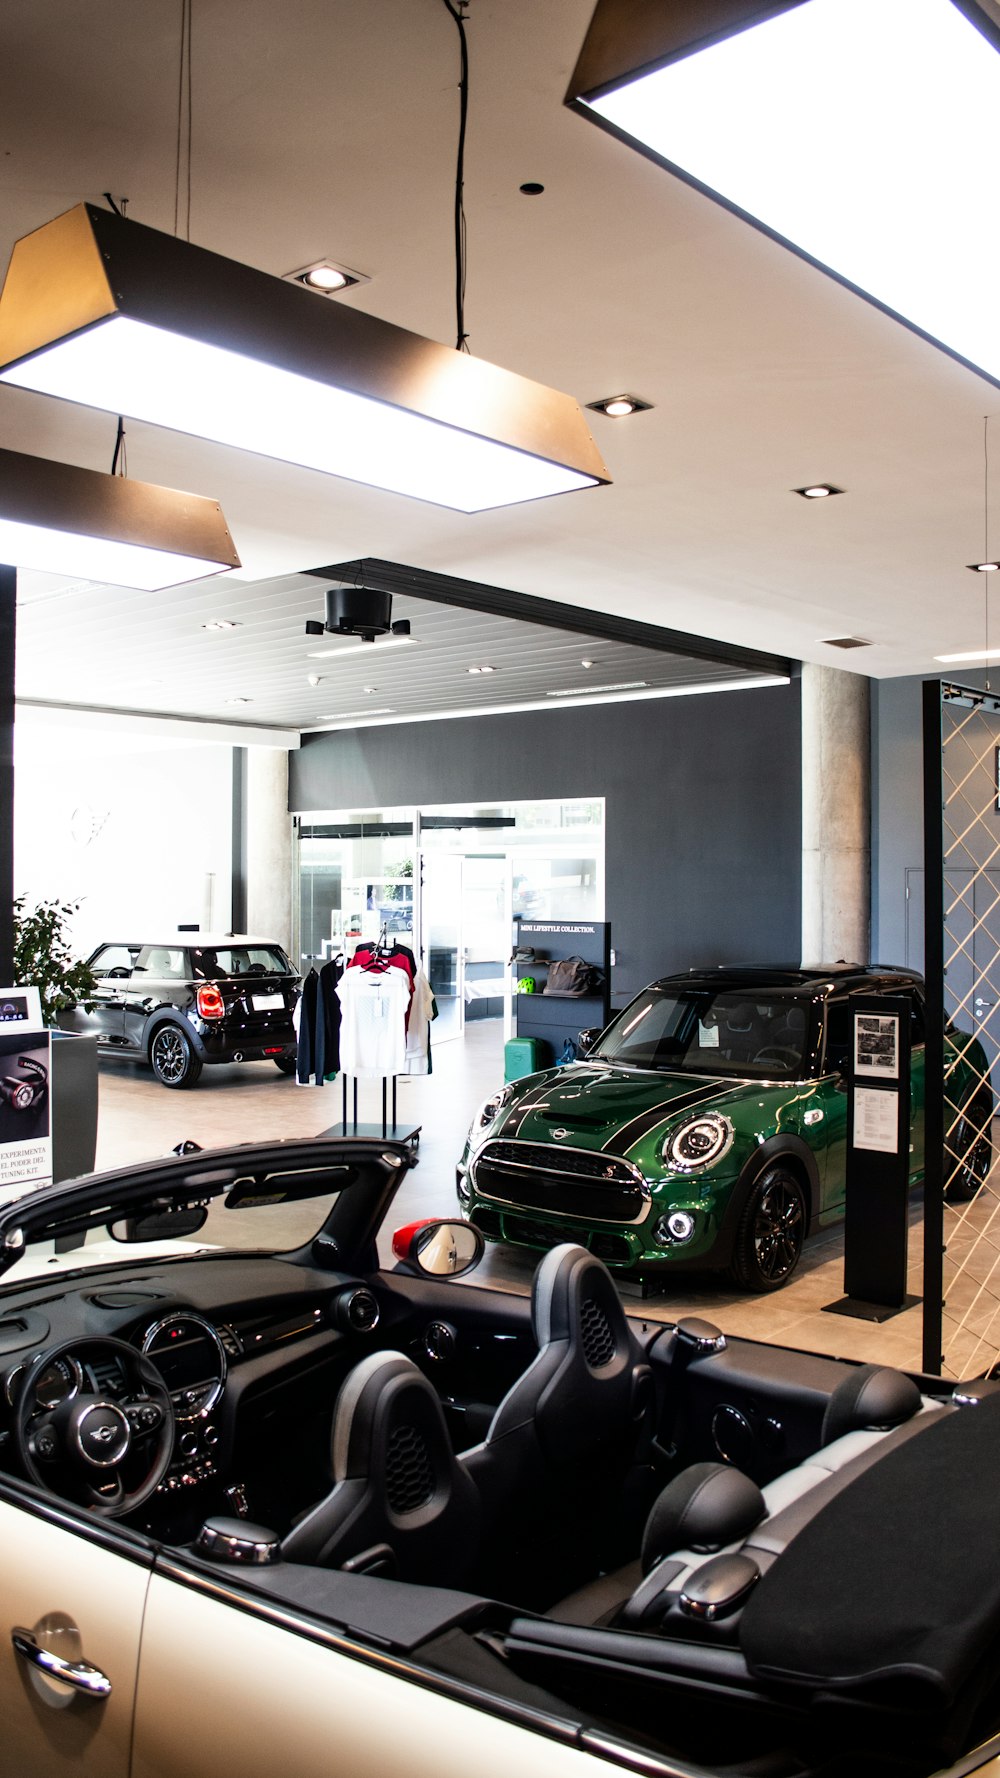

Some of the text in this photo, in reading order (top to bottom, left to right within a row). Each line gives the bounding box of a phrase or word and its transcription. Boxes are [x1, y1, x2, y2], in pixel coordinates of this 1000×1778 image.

[520, 924, 532, 932] MINI
[561, 925, 595, 933] COLLECTION.
[1, 1147, 46, 1160] EXPERIMENTA
[11, 1159, 31, 1168] PODER
[1, 1170, 25, 1179] TUNING
